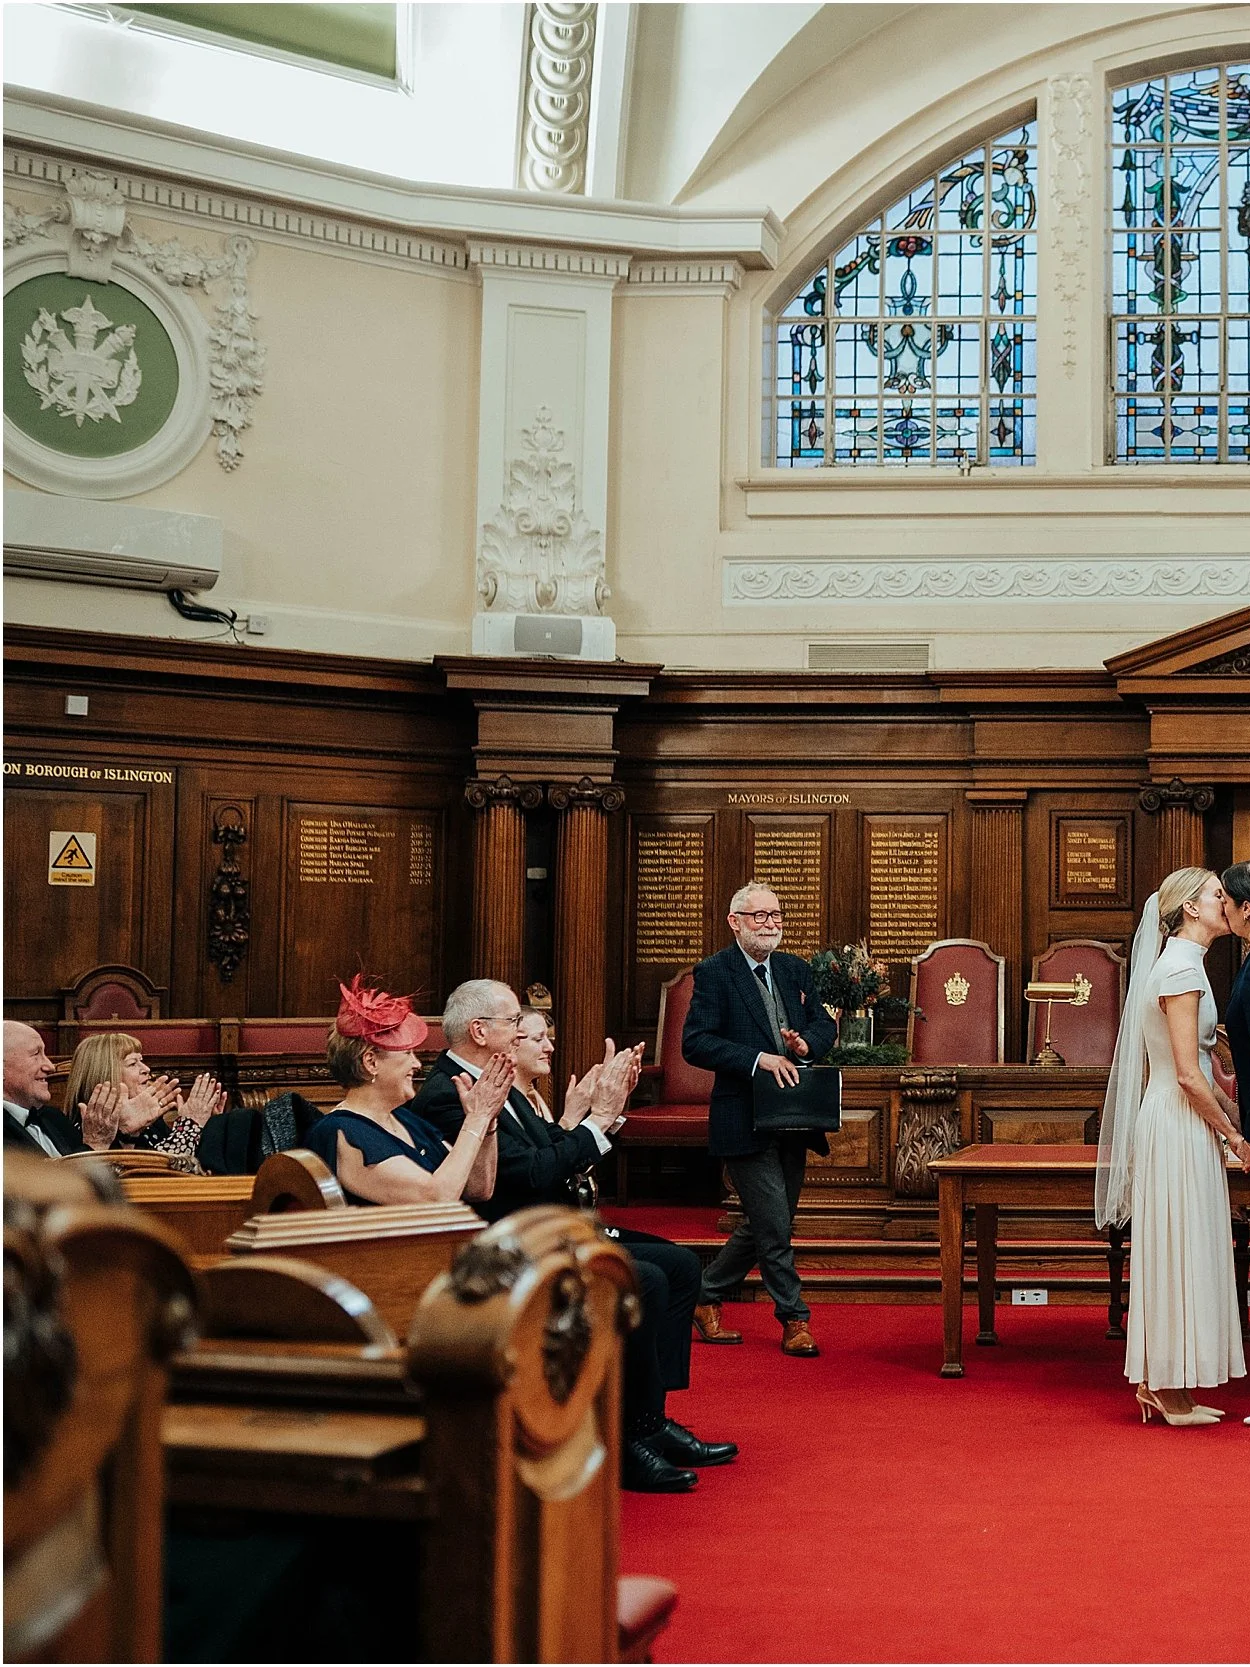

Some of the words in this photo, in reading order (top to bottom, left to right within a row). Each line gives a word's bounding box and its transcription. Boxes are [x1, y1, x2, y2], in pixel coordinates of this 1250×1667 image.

[25, 764, 88, 778] BOROUGH
[104, 768, 172, 784] ISLINGTON
[728, 794, 774, 804] MAYORS
